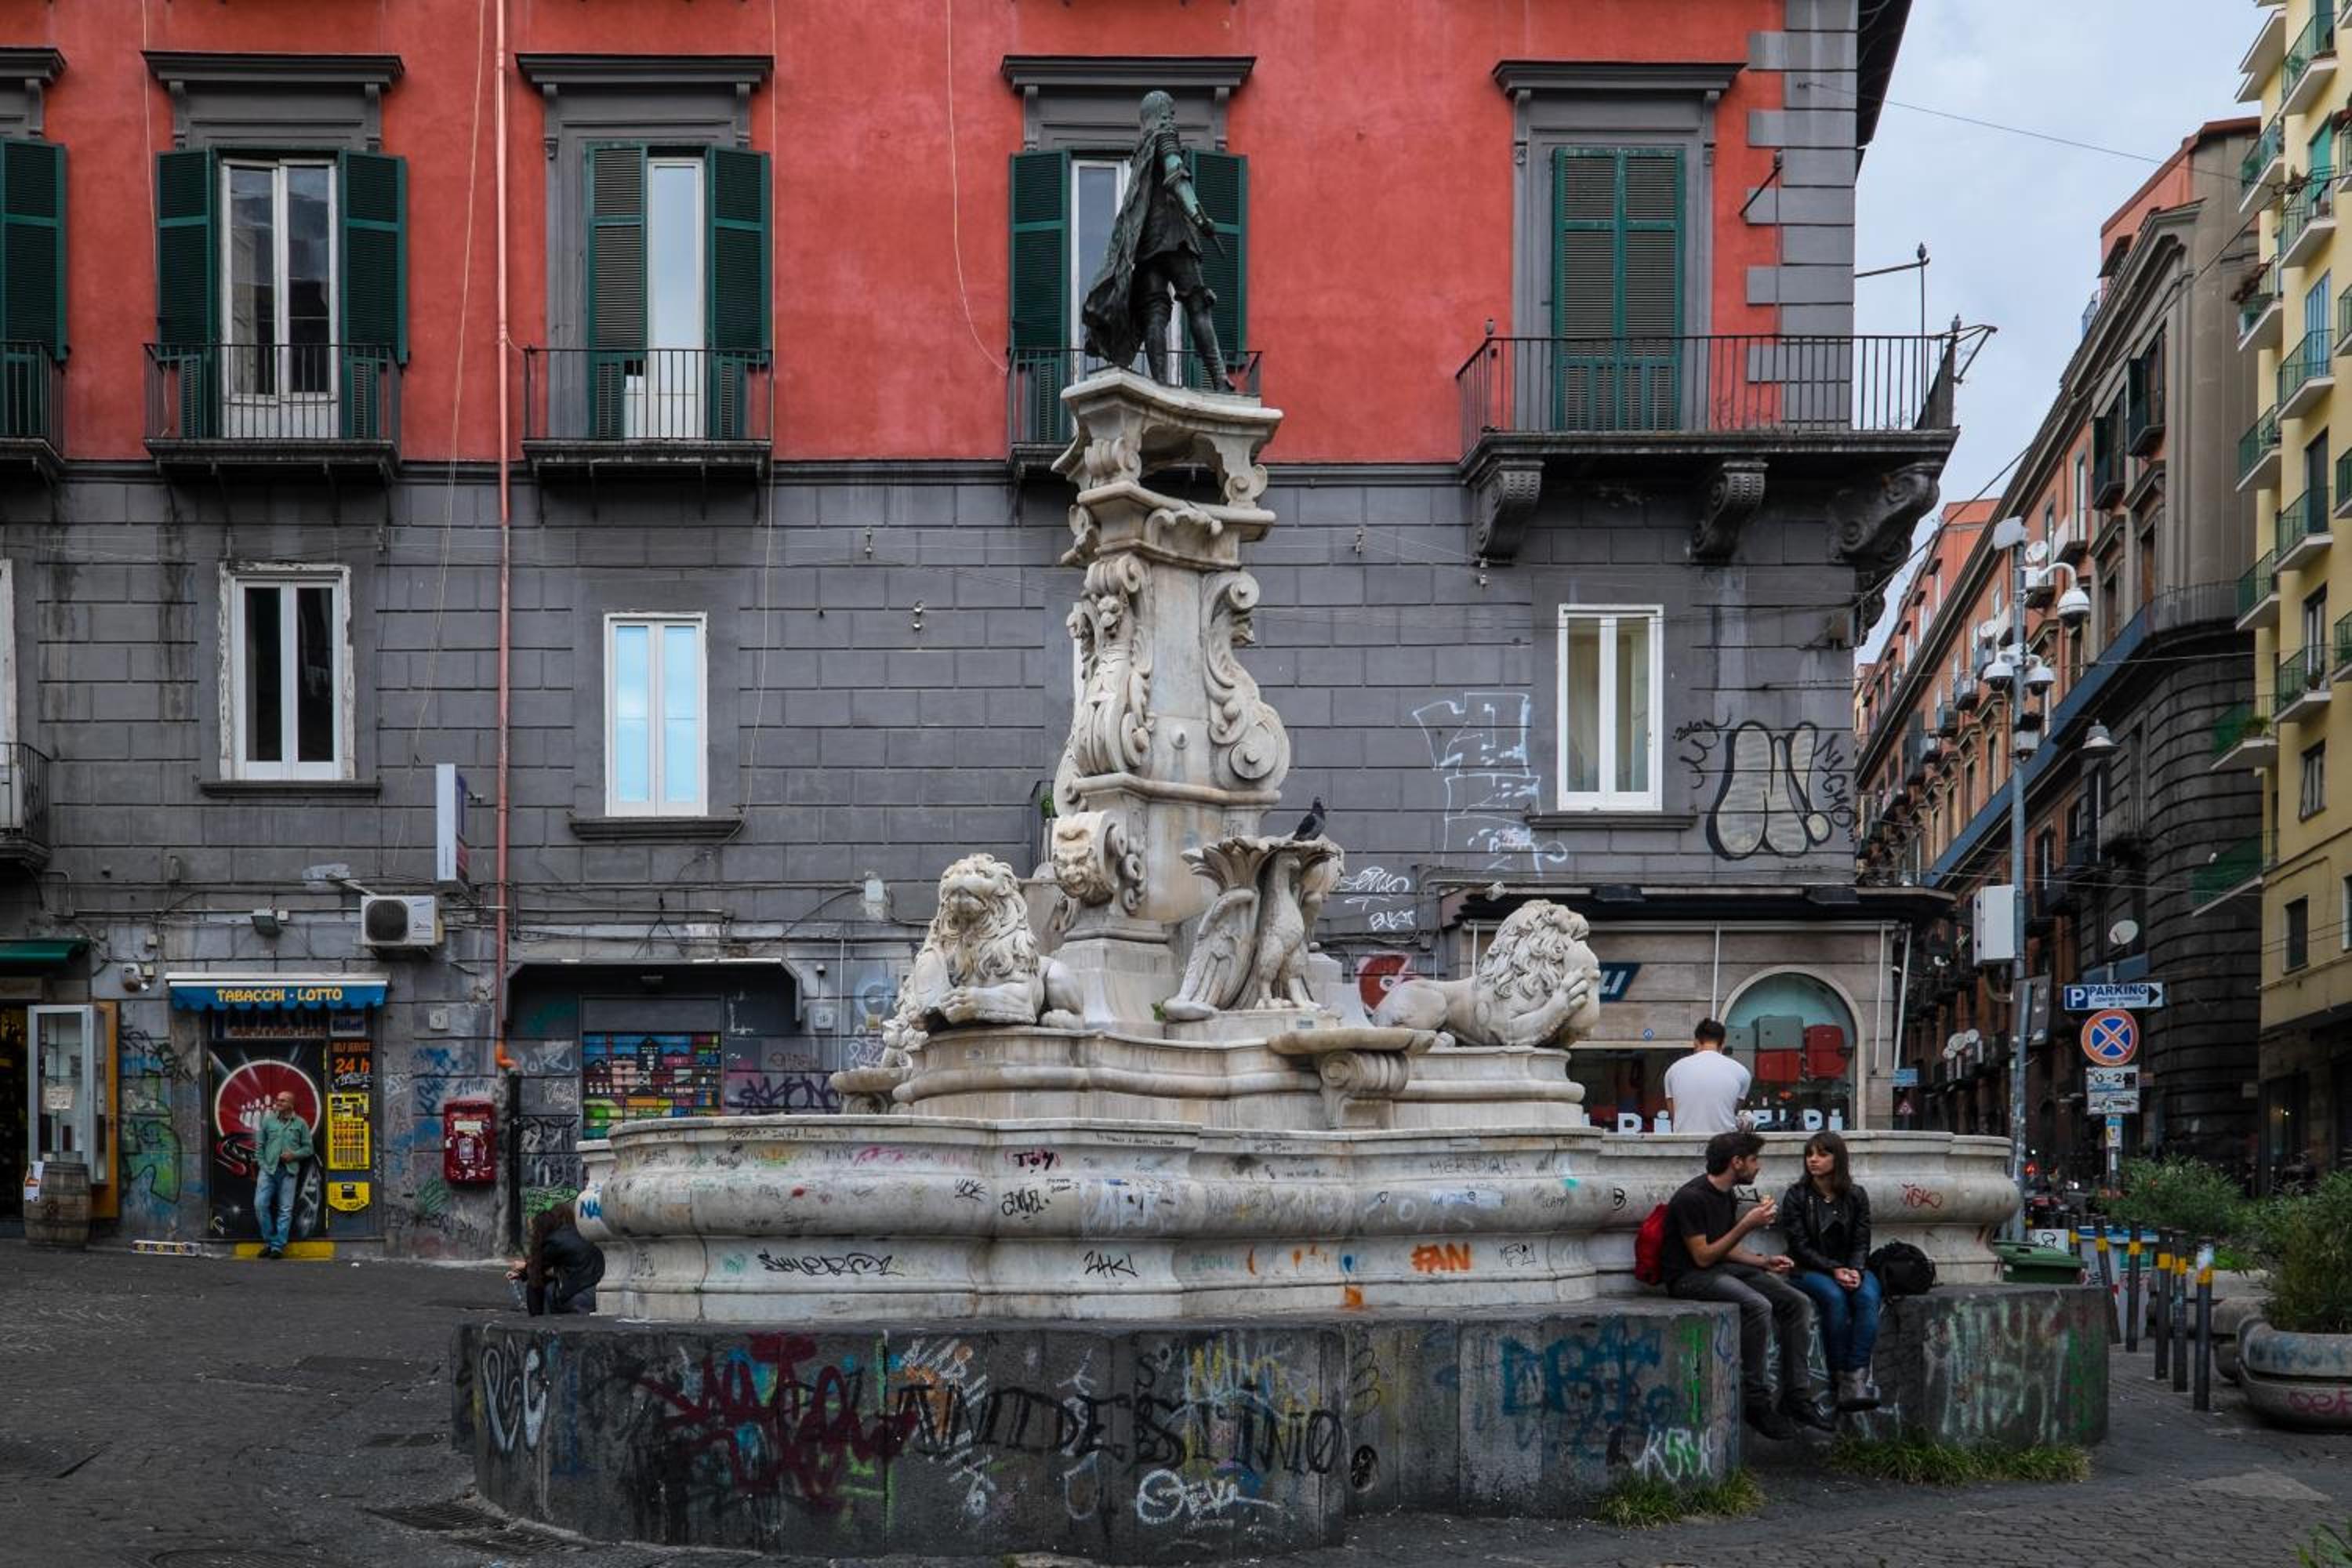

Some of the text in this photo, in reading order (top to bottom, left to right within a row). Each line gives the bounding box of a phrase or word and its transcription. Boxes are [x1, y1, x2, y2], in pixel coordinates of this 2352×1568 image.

[216, 989, 285, 1003] TABACCHI
[297, 988, 343, 1001] LOTTO
[2090, 985, 2147, 995] PARKING
[335, 1057, 355, 1074] 24
